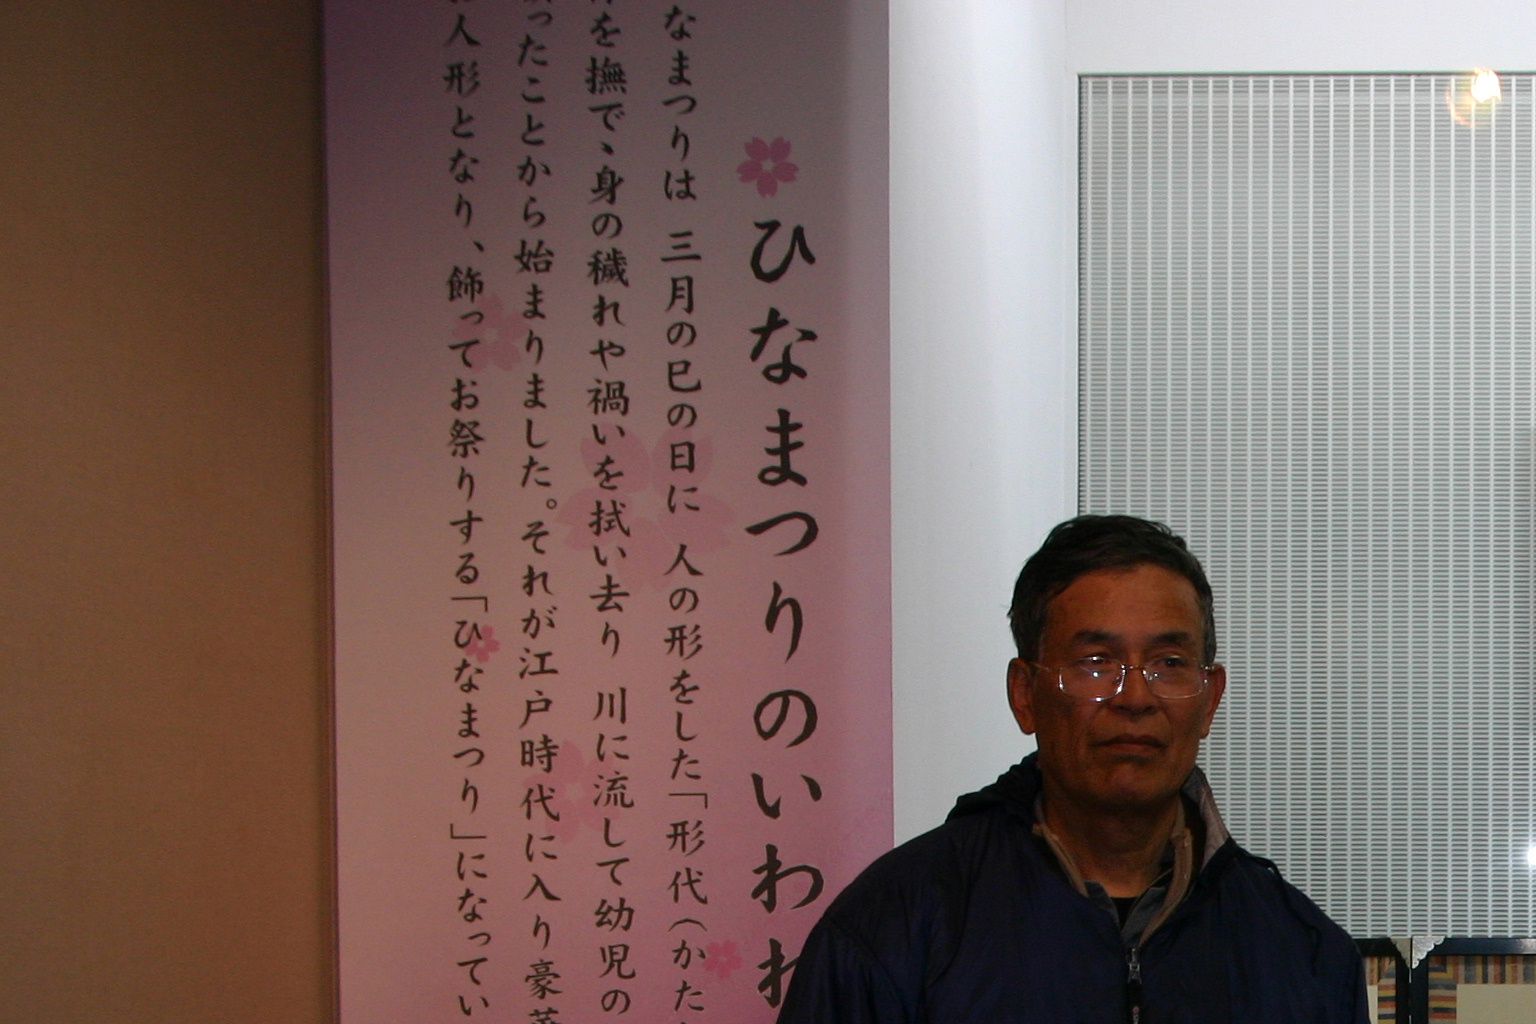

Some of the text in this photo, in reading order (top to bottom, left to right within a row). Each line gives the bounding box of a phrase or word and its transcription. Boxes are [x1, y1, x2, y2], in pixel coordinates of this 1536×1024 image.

[585, 0, 632, 658] を撫で、身の穢れや禍いを拭い去り
